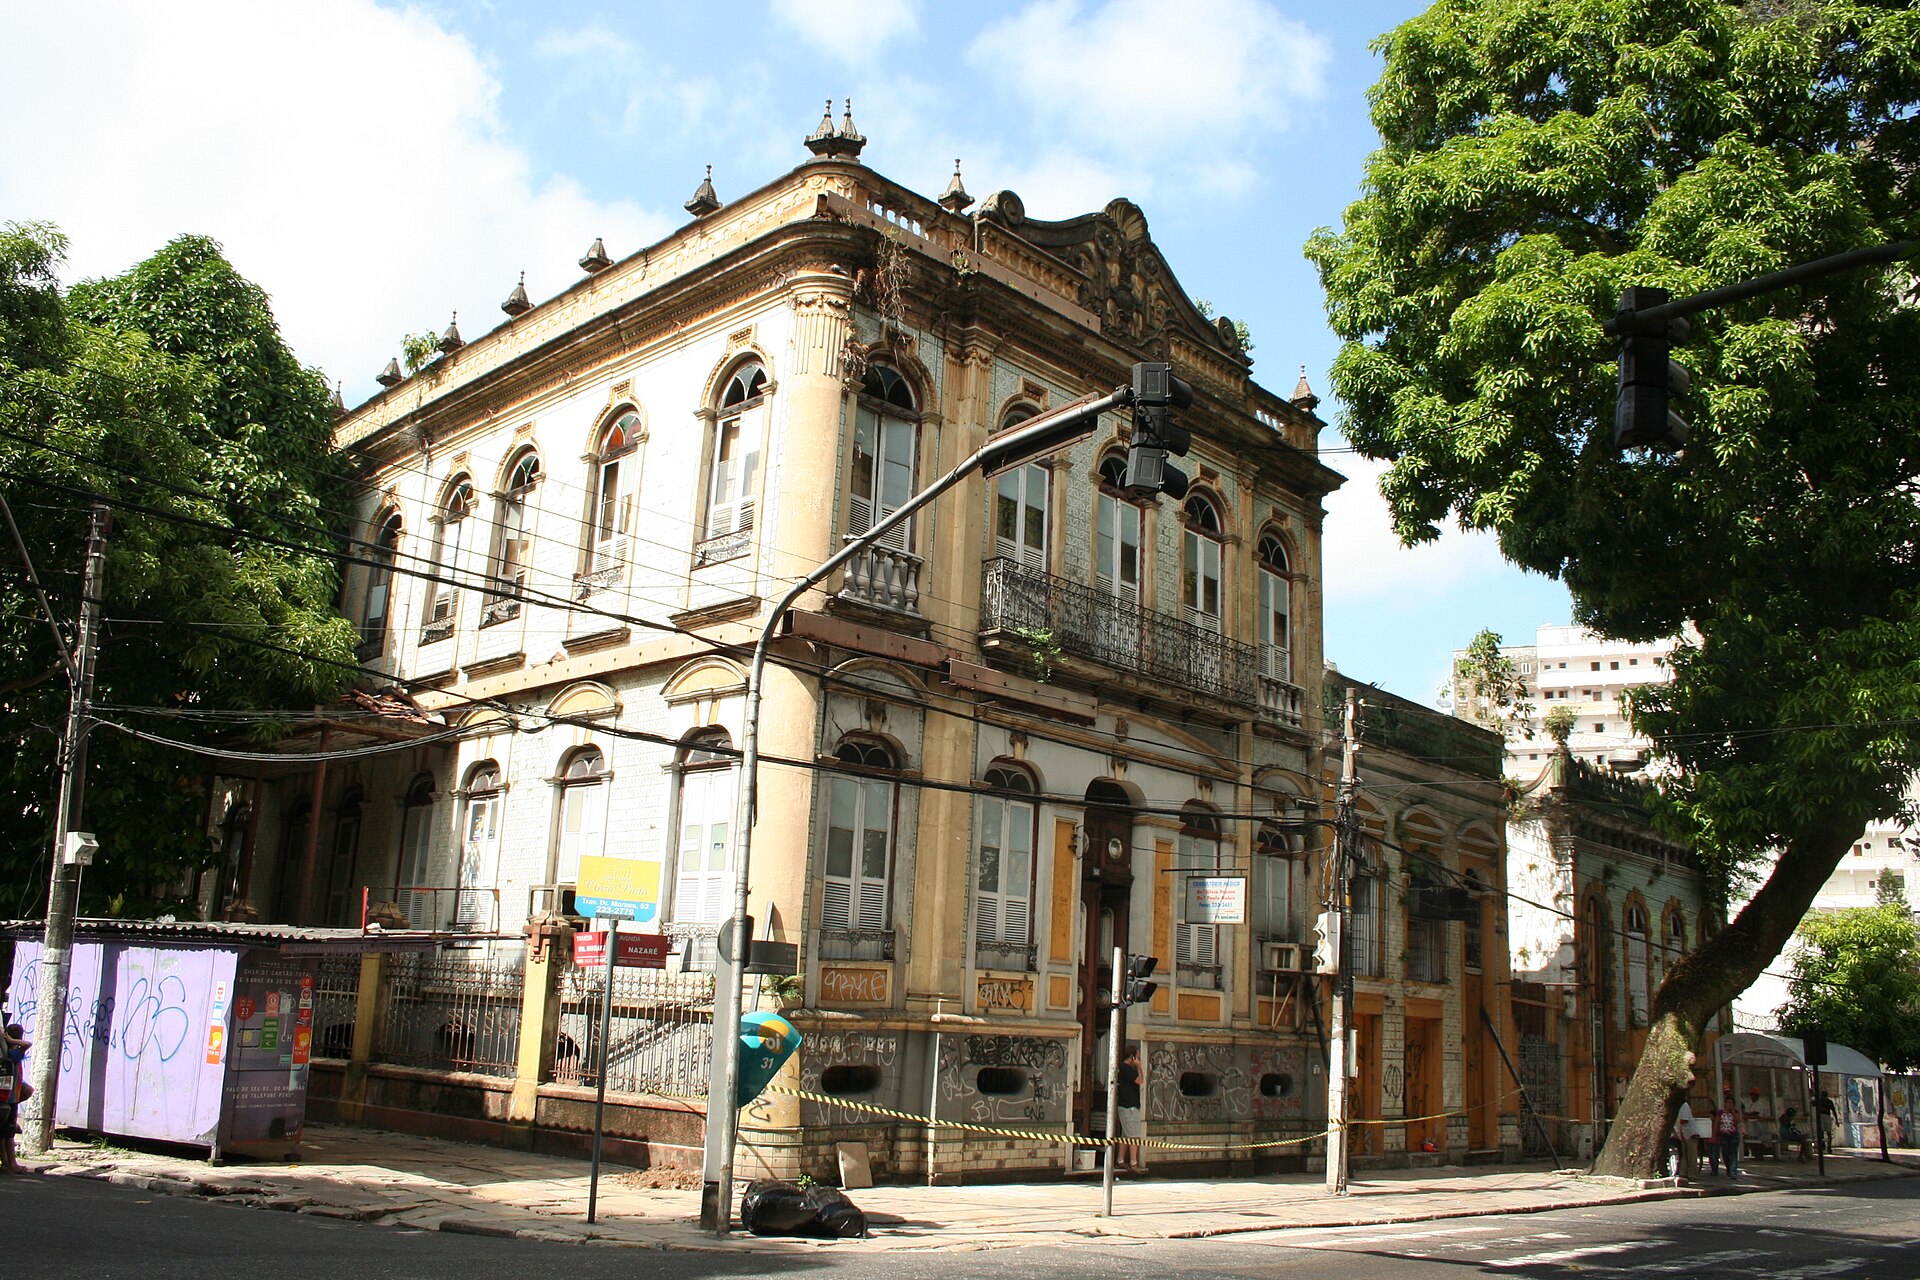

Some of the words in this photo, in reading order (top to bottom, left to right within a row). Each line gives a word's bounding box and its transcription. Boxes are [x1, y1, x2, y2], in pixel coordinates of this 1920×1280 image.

[596, 905, 635, 915] 223-2779
[628, 945, 659, 956] NAZARÉ
[765, 1033, 780, 1050] oi
[760, 1057, 774, 1070] 31
